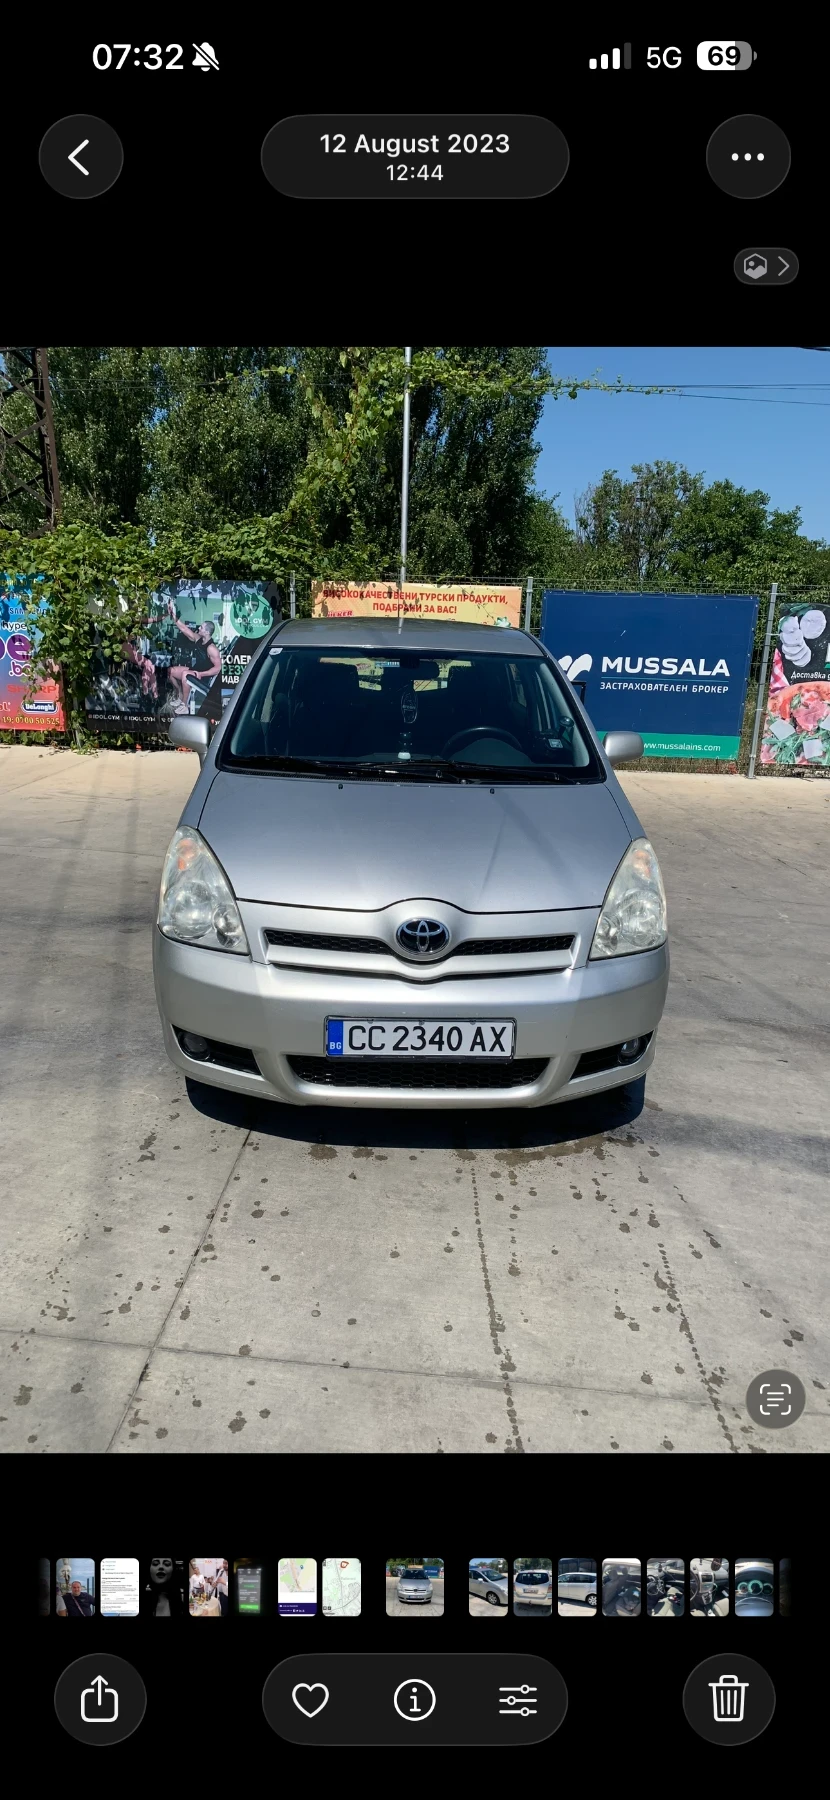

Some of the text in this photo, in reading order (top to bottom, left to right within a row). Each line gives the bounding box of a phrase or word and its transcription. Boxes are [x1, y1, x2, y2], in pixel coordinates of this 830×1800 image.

[322, 589, 508, 604] ВИСОКОКАЧЕСТВЕНИ ТУРСКИ ПРОДУКТИ,
[372, 602, 457, 614] ПОДБРАНИ ЗА ВАС!
[601, 656, 730, 677] MUSSALA
[600, 682, 729, 694] ЗАСТРАХОВАТЕЛЕН БРОКЕР
[329, 1025, 507, 1052] BG CC 2340 AX
